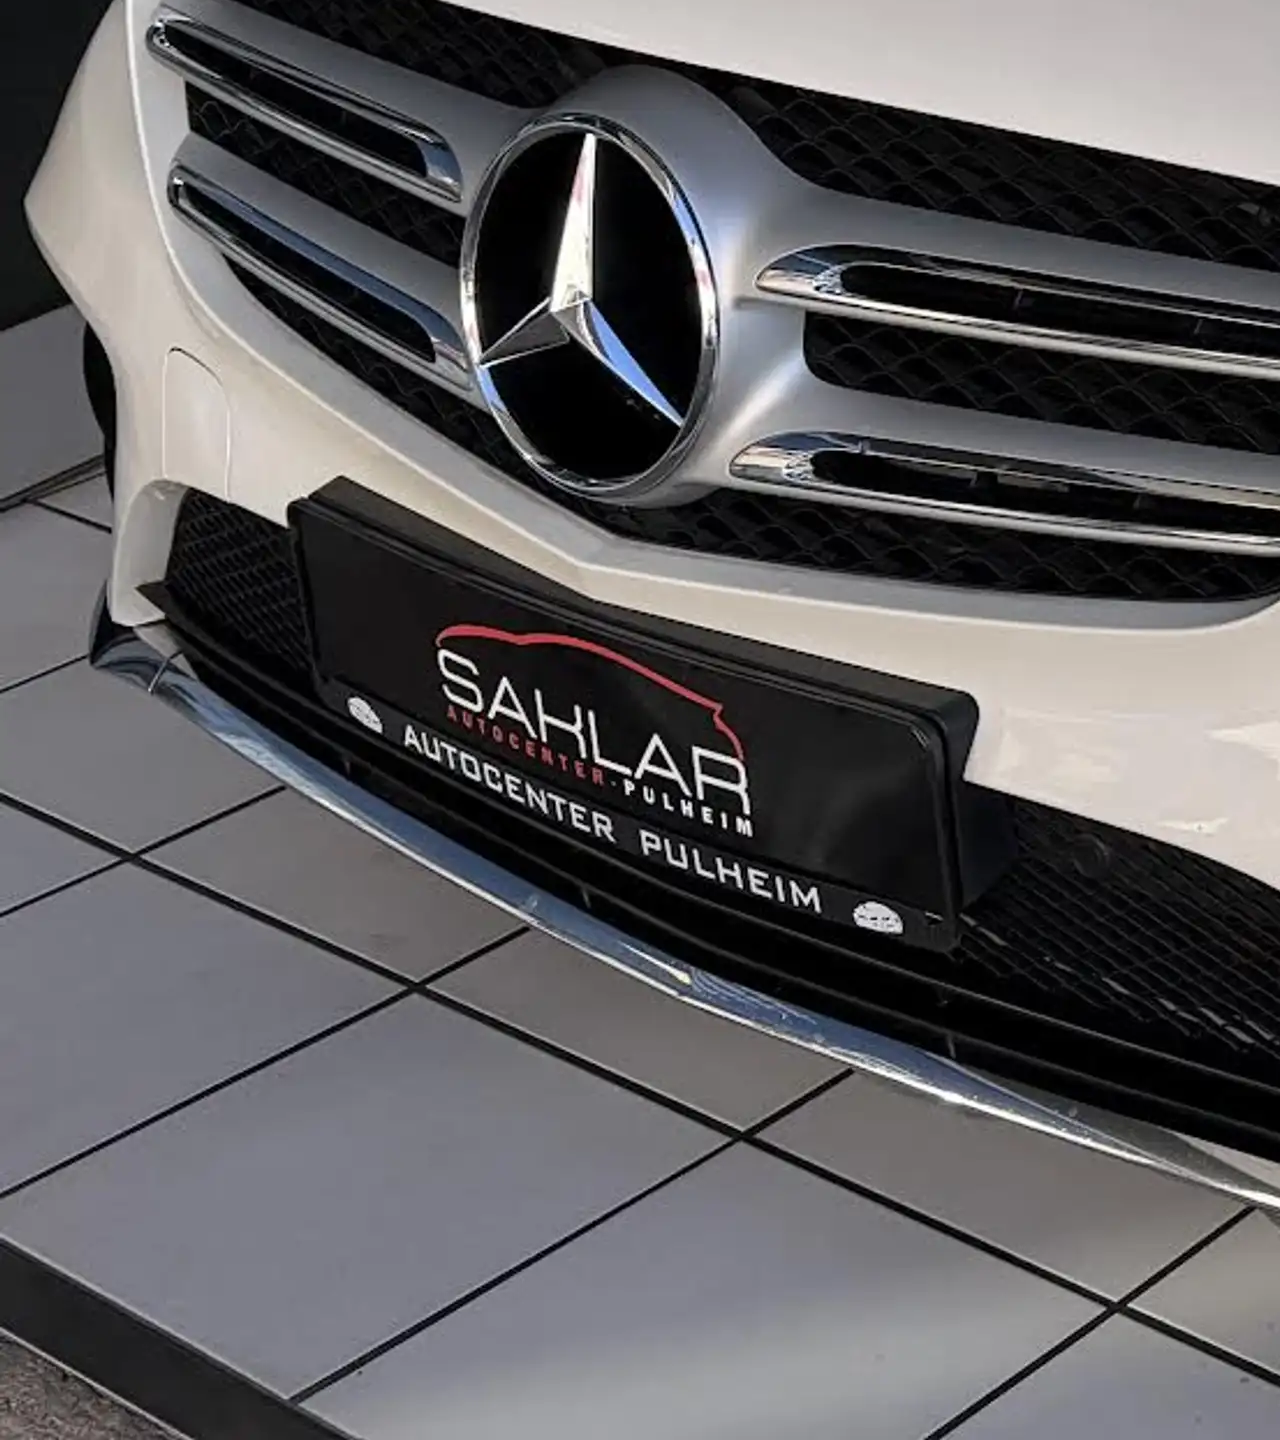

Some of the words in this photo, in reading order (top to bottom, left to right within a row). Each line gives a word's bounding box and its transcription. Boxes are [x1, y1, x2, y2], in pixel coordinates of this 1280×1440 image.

[436, 648, 751, 815] SAHLAR
[447, 704, 605, 787] AUTOCENTER
[622, 777, 753, 838] PULHEIM
[403, 724, 616, 845] AUTOCENTER
[638, 828, 823, 914] PULHEIM
